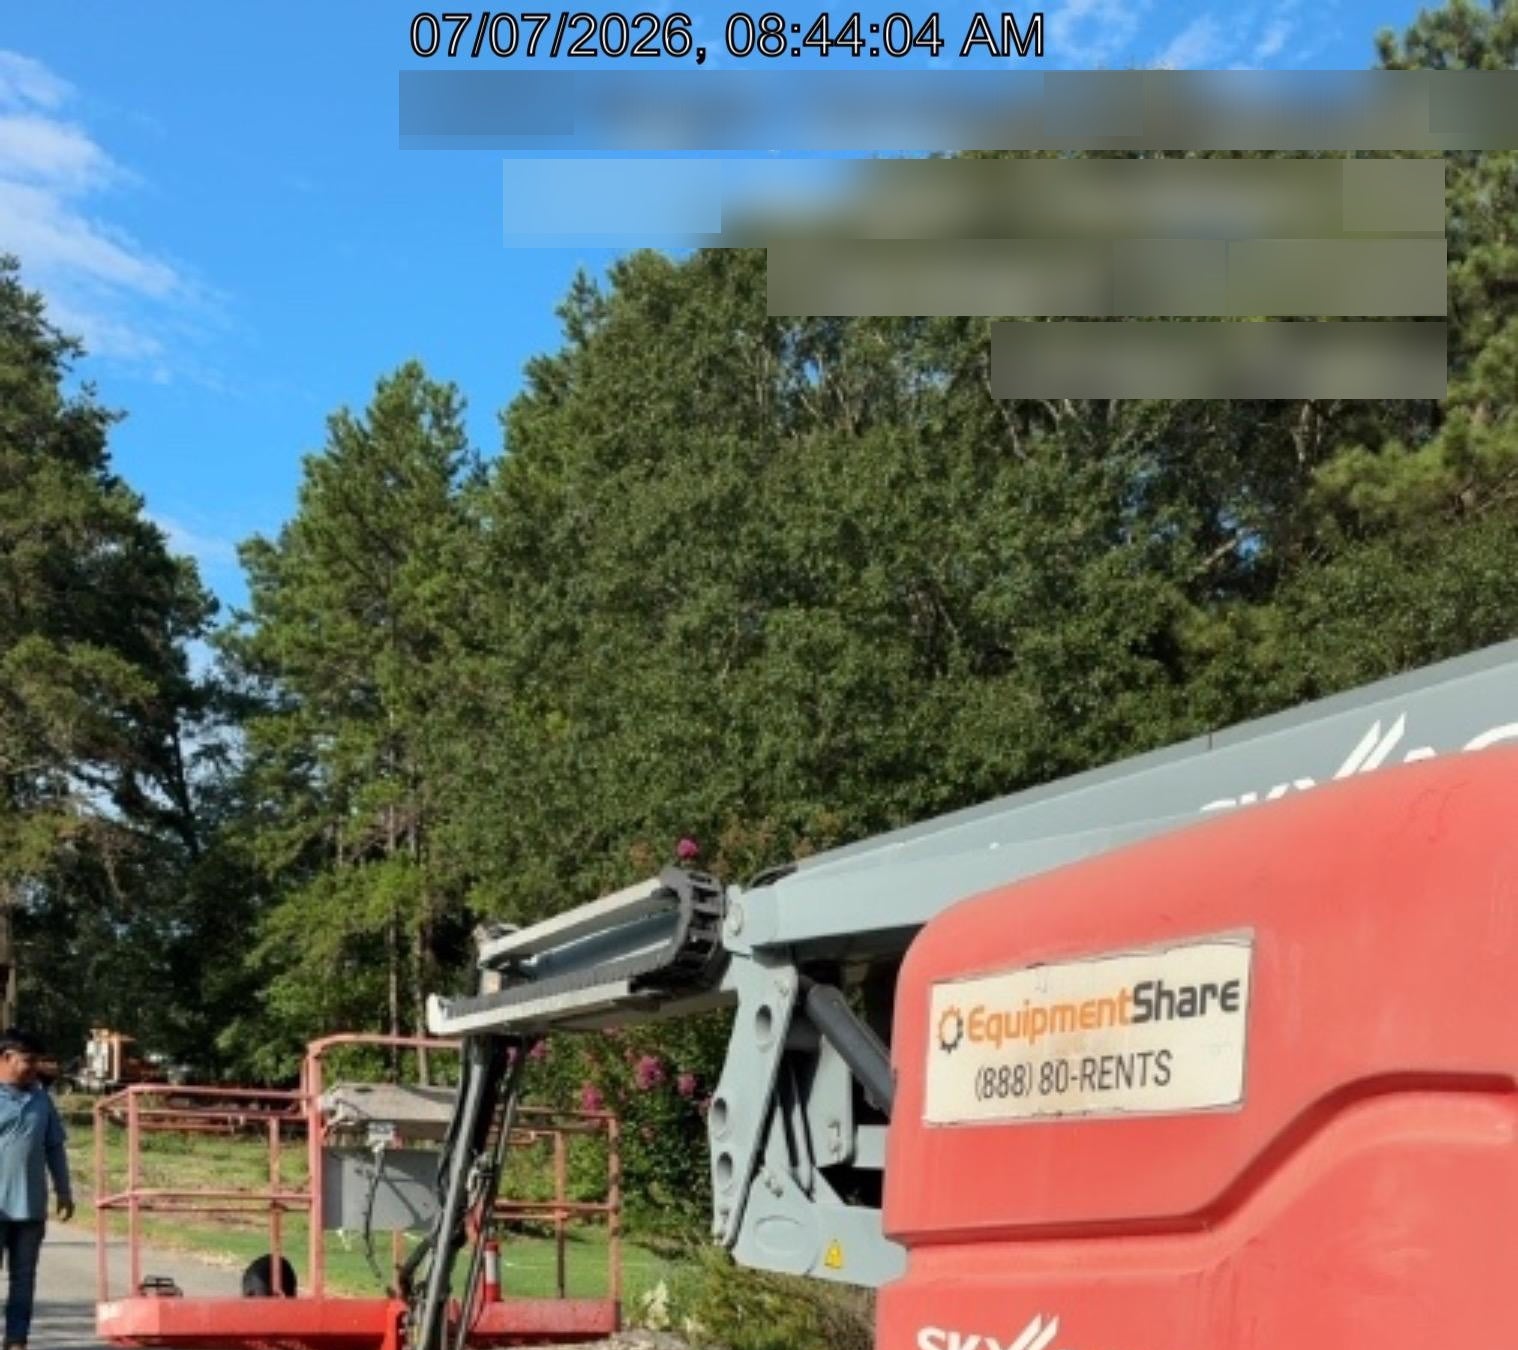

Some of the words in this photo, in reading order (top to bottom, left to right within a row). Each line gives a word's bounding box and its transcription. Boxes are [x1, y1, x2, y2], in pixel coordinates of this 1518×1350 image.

[967, 979, 1240, 1048] EquipmentShare
[974, 1062, 1032, 1101] (888)
[1039, 1049, 1172, 1095] 80-RENTS
